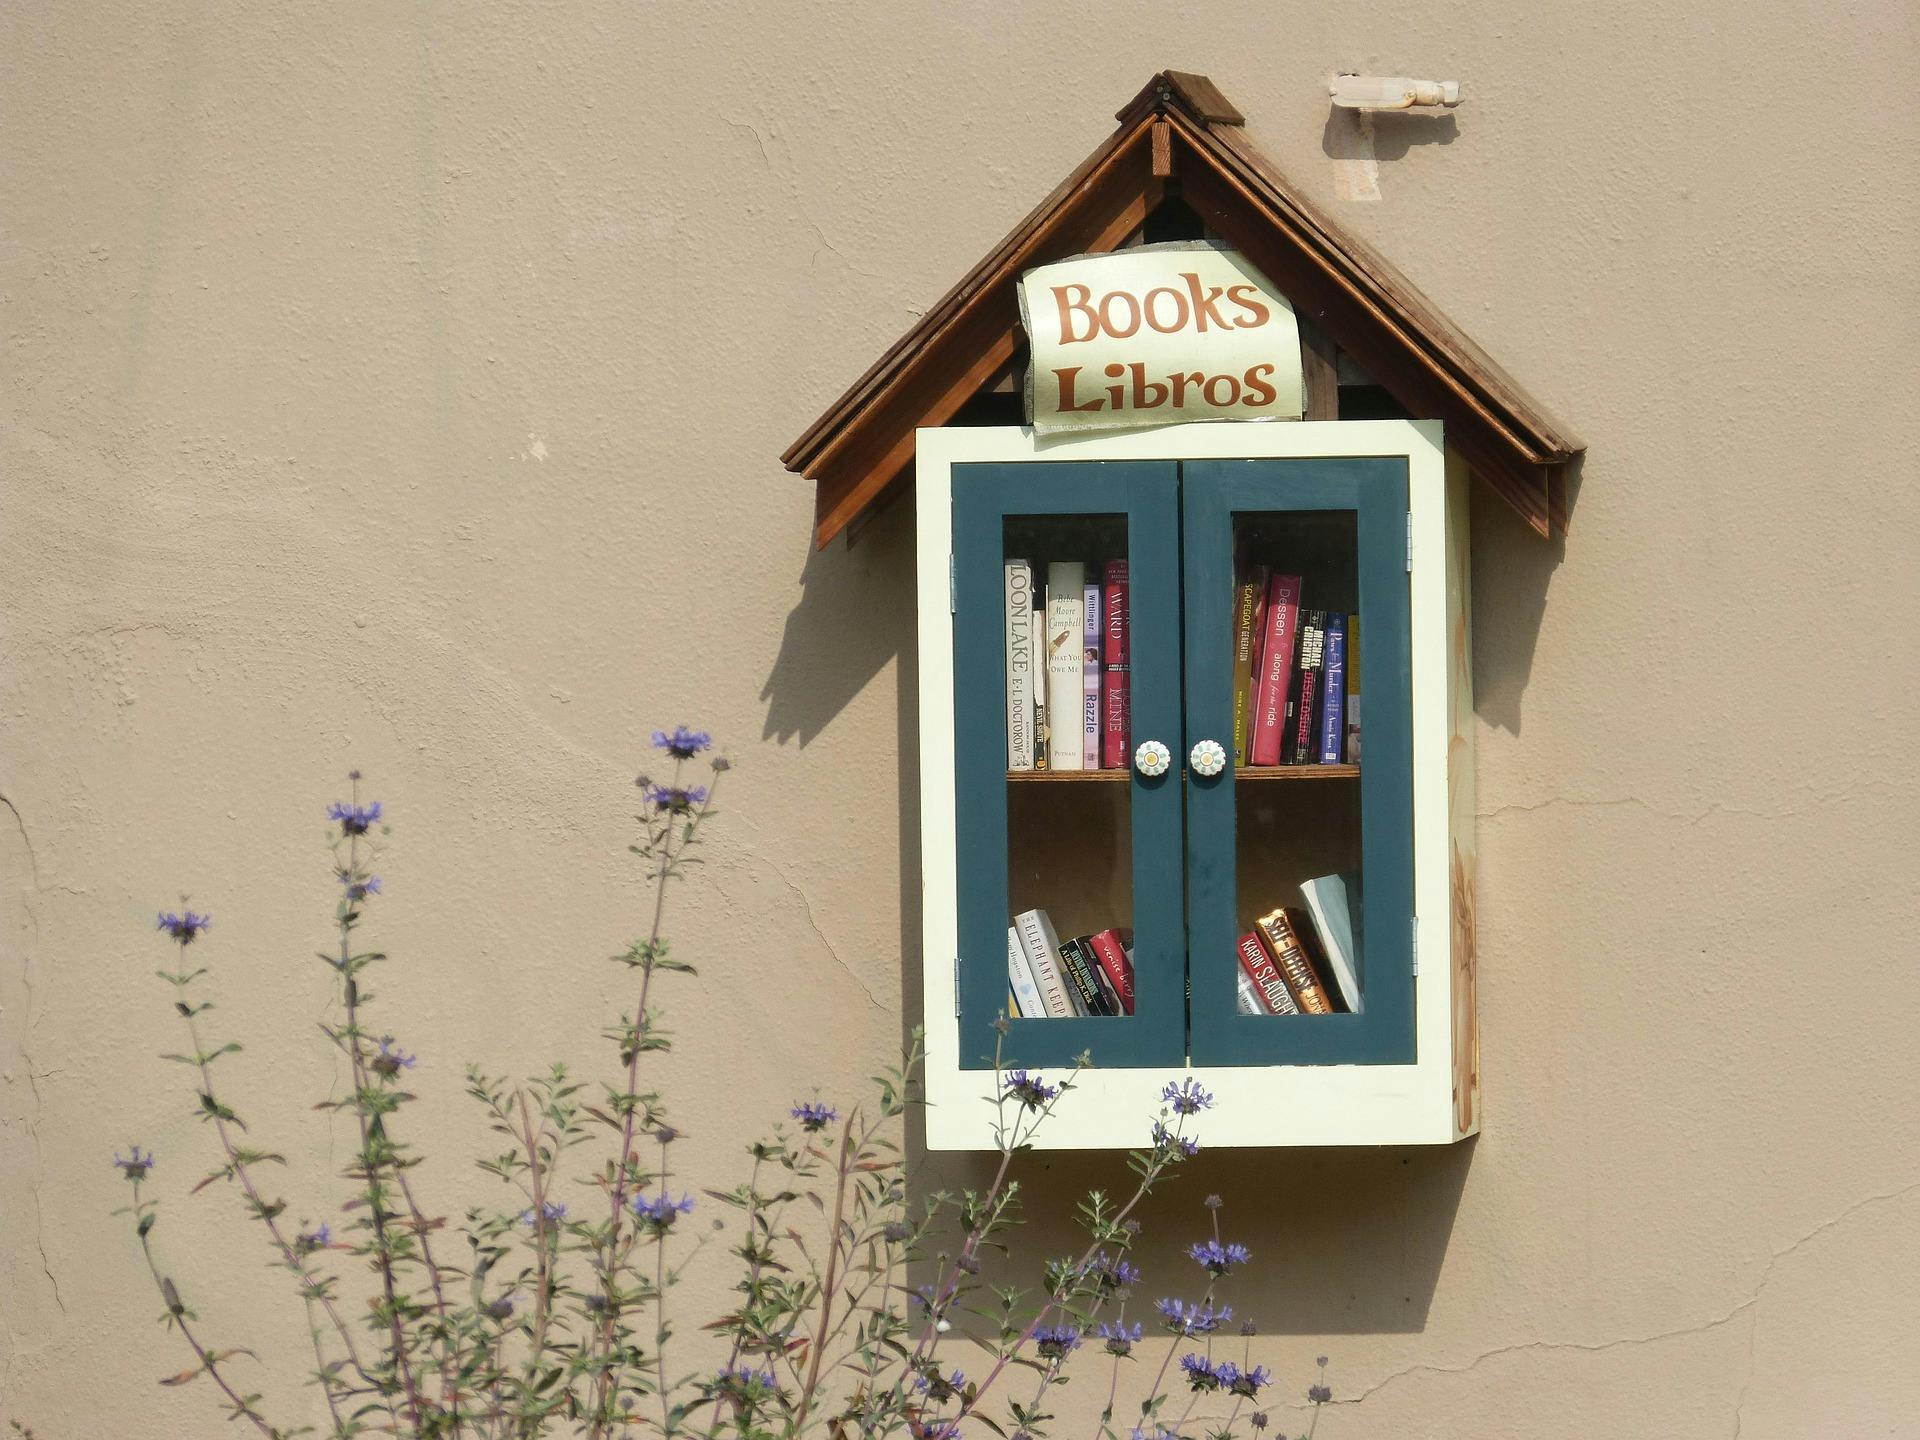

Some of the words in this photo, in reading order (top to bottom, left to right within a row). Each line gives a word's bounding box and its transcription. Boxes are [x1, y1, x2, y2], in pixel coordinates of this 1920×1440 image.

[1050, 273, 1270, 345] Books
[1051, 362, 1277, 413] Libros
[1010, 566, 1028, 618] LOON
[1088, 594, 1096, 630] Wittlinger
[1241, 583, 1253, 632] SCAPEGOAT
[1275, 588, 1291, 636] Dessen
[1048, 617, 1081, 630] Campbell
[1110, 592, 1123, 639] WARD
[1011, 621, 1028, 672] LAKE
[1240, 631, 1250, 662] GENERATION
[1300, 626, 1314, 670] CRICHTON
[1310, 630, 1324, 667] MICHAEL
[1329, 632, 1343, 652] Paws
[1271, 653, 1283, 681] along
[1328, 662, 1342, 693] Murder
[1012, 699, 1024, 753] DOCTOROW
[1085, 694, 1098, 733] Razzle
[1109, 688, 1123, 731] MINE
[1267, 707, 1277, 727] ride
[1298, 671, 1314, 744] DISCLOSURE
[1025, 924, 1055, 982] ELEPHANT
[1047, 986, 1068, 1017] KEEP
[1103, 945, 1121, 974] venise
[1241, 938, 1266, 969] KARIN
[1082, 990, 1094, 1004] Dick
